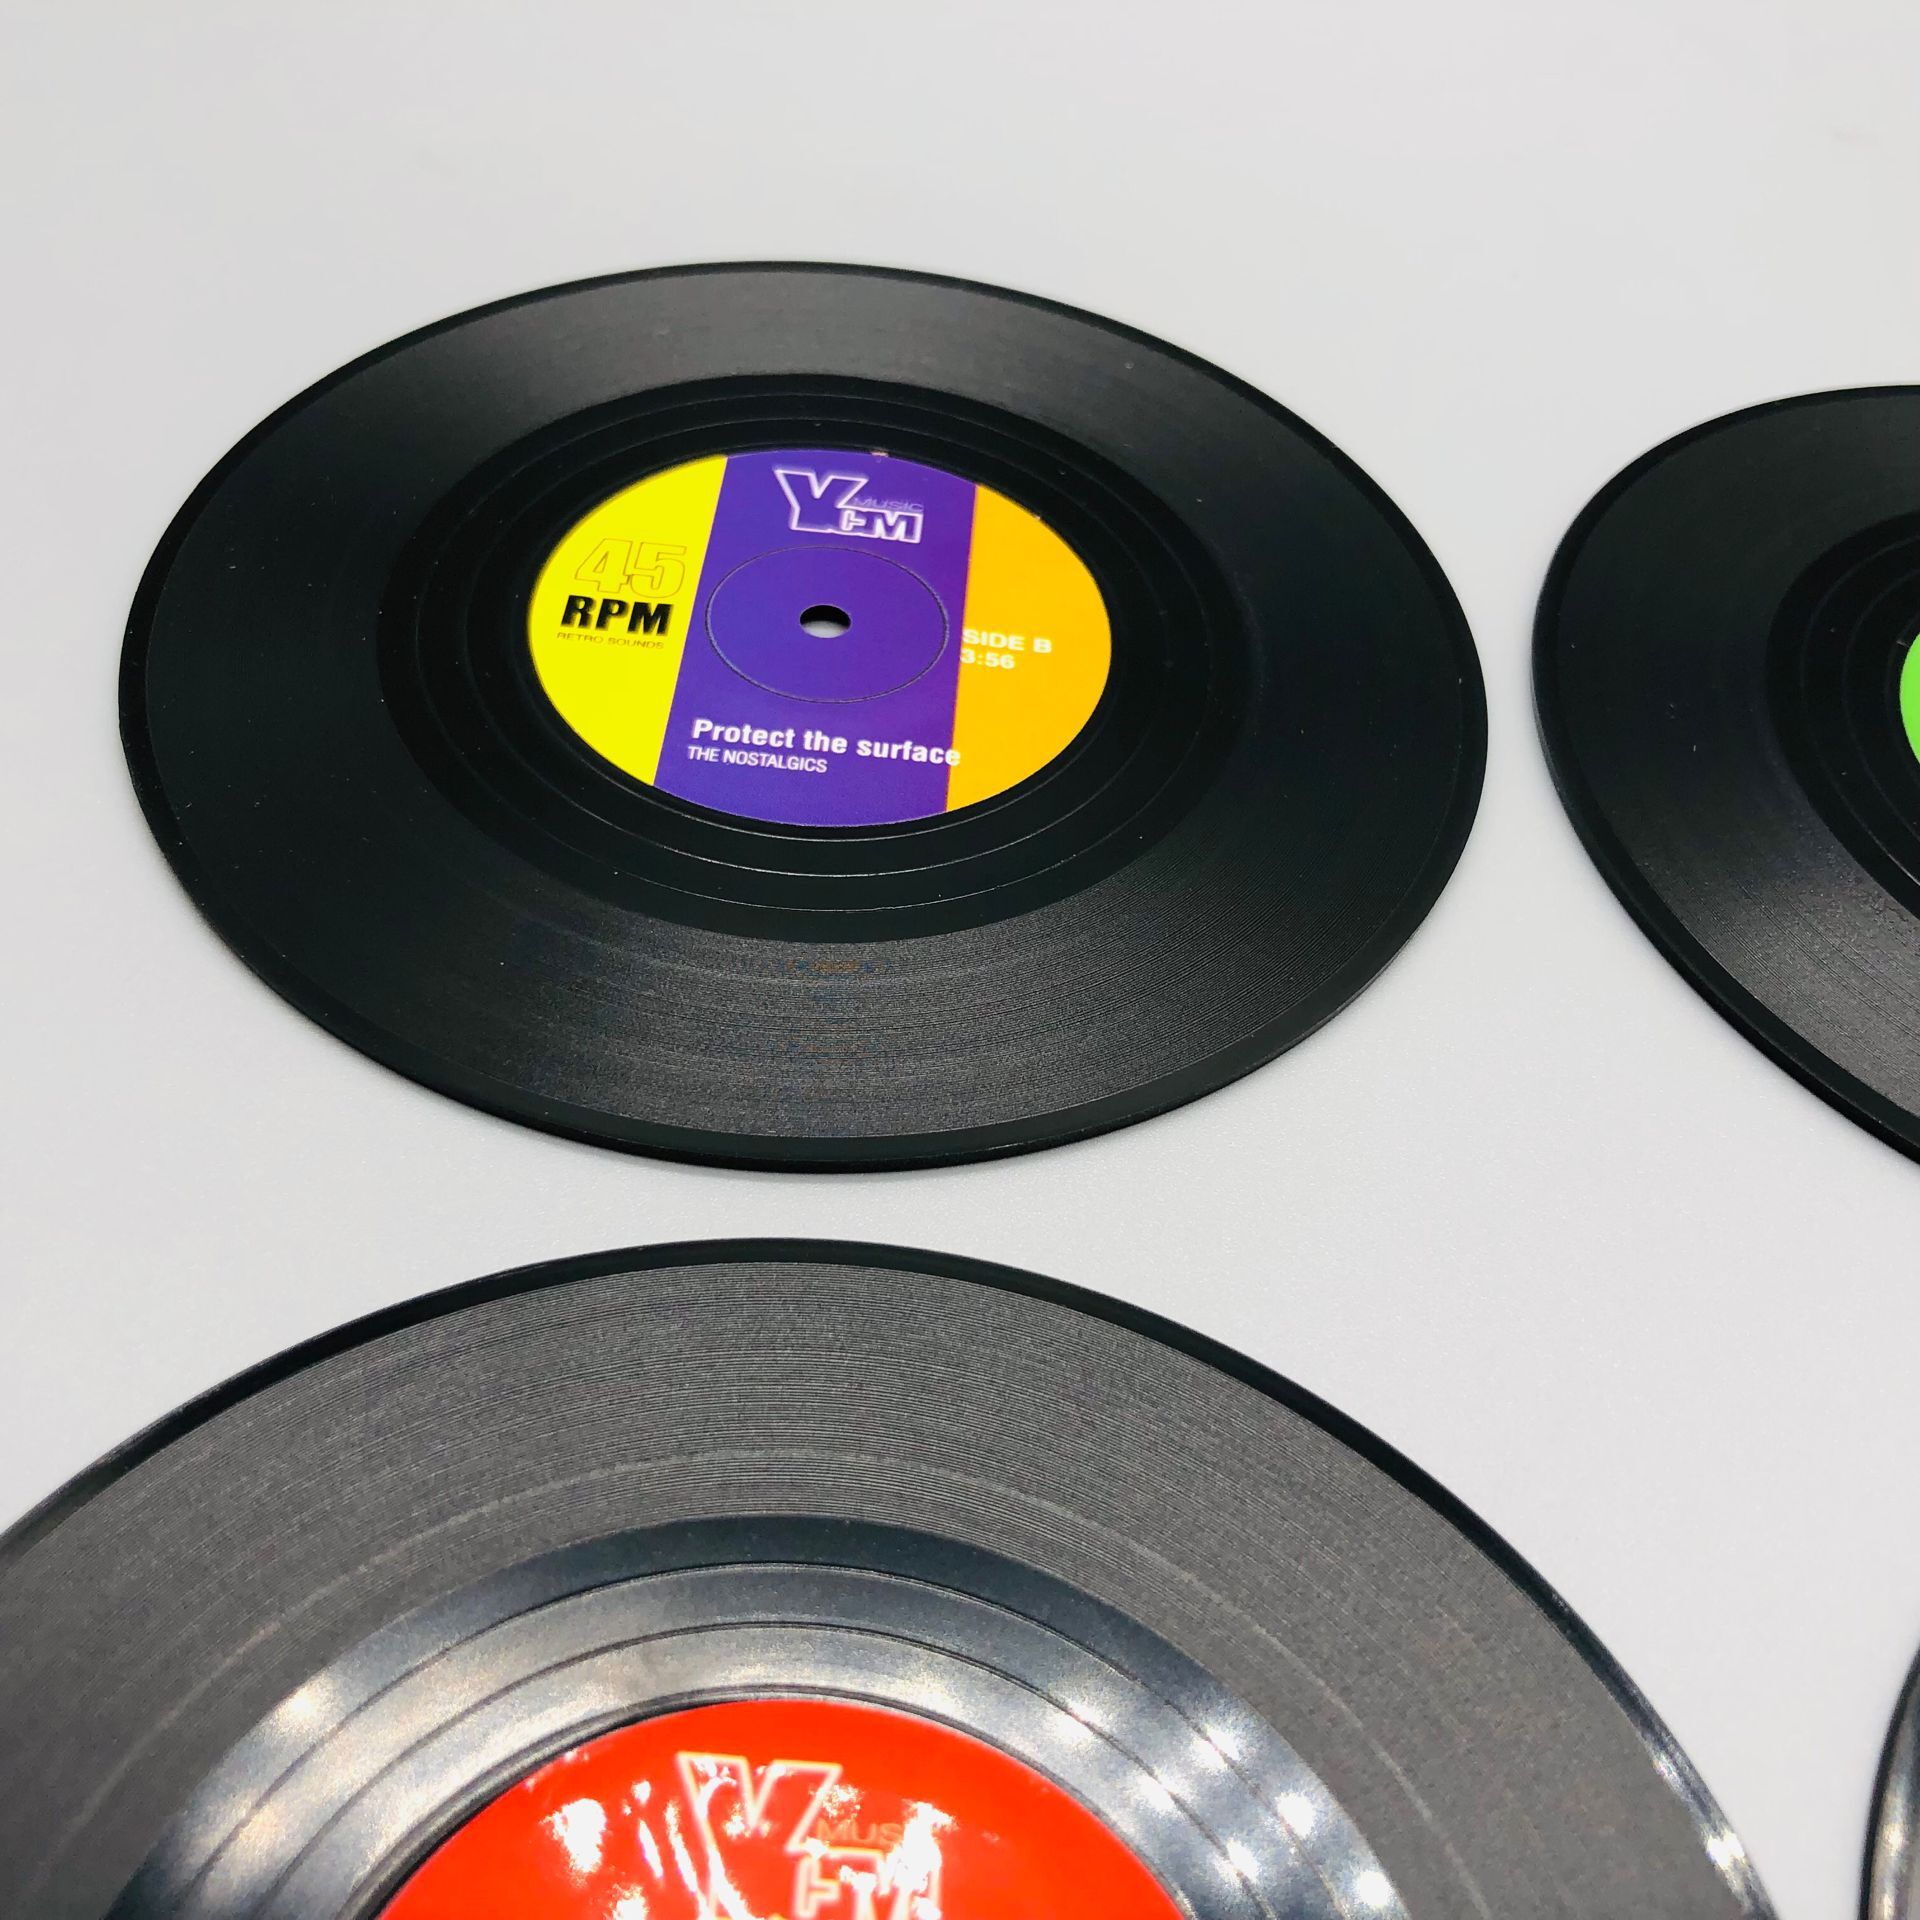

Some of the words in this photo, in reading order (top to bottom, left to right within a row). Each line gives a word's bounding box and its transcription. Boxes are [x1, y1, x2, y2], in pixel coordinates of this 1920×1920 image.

[852, 497, 925, 513] MUSIC
[574, 538, 688, 598] 45
[560, 595, 674, 636] RPM
[557, 632, 604, 644] RETRO
[607, 637, 665, 649] SOUNDS
[962, 628, 1025, 651] SIDE
[1033, 637, 1052, 654] B
[960, 648, 1015, 670] 3:56
[692, 718, 796, 749] Protect
[804, 730, 848, 754] the
[857, 739, 961, 767] surface
[688, 746, 720, 763] THE
[723, 750, 828, 773] NOSTALGICS
